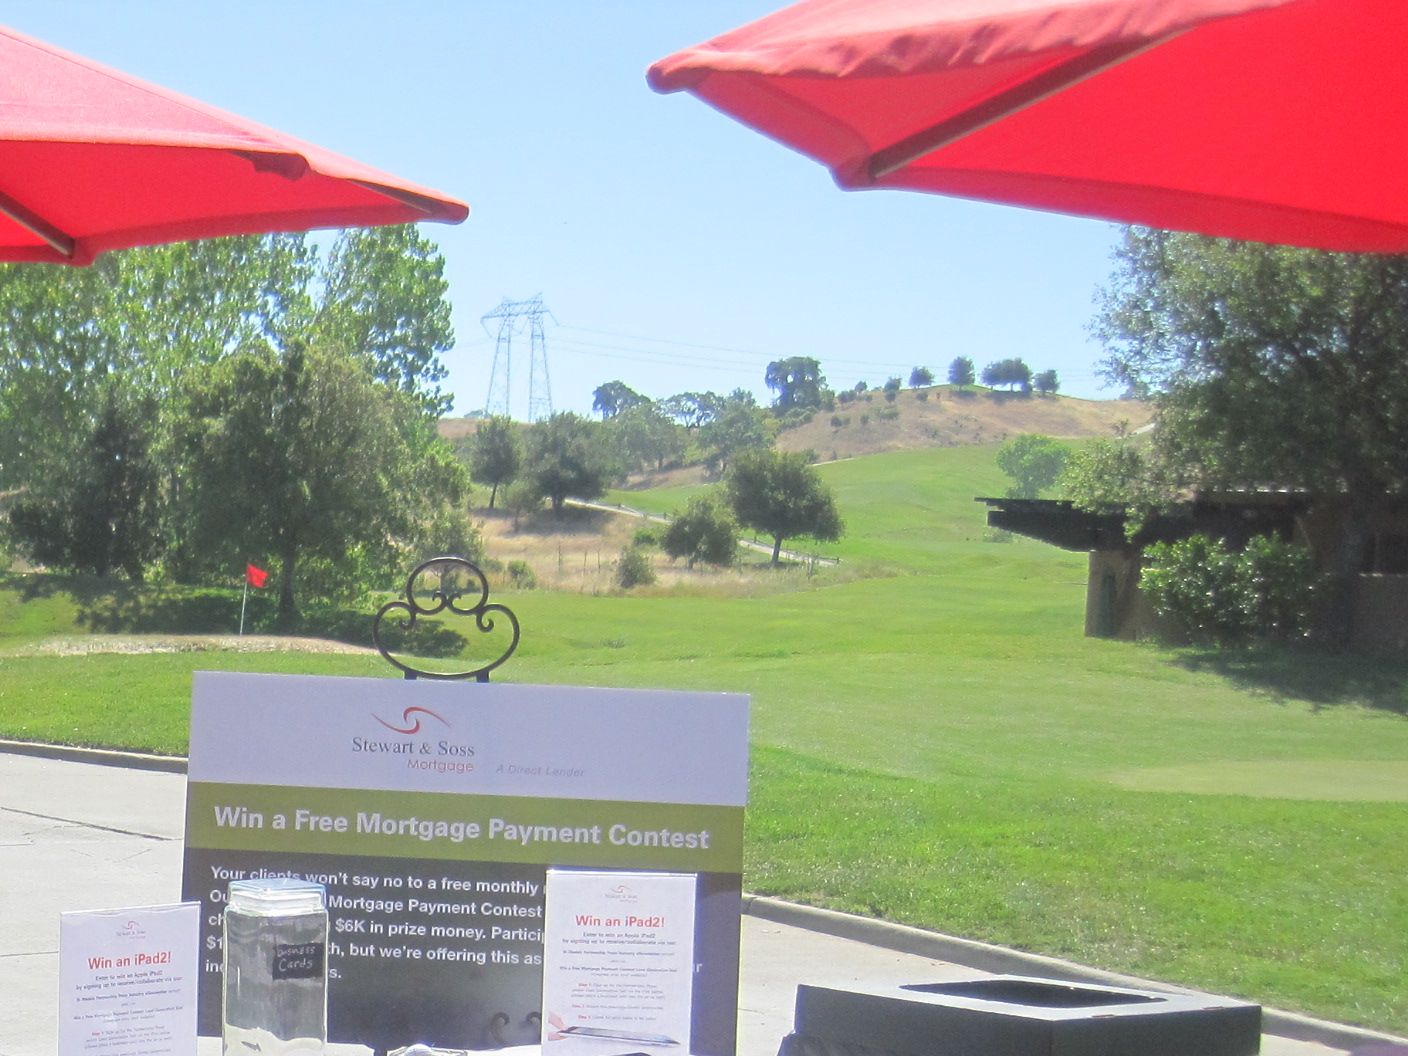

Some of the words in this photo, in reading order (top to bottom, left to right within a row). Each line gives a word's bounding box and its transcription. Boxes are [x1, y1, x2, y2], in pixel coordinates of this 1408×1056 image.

[352, 737, 414, 755] Stewart
[419, 742, 431, 755] &
[437, 741, 475, 757] Soss
[407, 758, 474, 774] Mortgage
[214, 806, 264, 829] Win
[272, 814, 286, 830] a
[294, 809, 348, 833] Free
[356, 812, 480, 843] Mortgage
[489, 817, 601, 846] Payment
[608, 823, 710, 850] Contest
[211, 865, 246, 881] Your
[306, 871, 349, 886] won't
[352, 874, 379, 889] say
[383, 876, 403, 889] no
[408, 875, 423, 889] to
[427, 879, 437, 890] a
[441, 877, 472, 891] free
[476, 880, 539, 897] monthly
[328, 895, 404, 914] Mortgage
[408, 899, 476, 916] Payment
[481, 902, 542, 918] Contest
[335, 918, 366, 934] $6K
[370, 920, 384, 934] in
[388, 922, 427, 937] prize
[431, 926, 487, 940] money.
[575, 914, 600, 926] Win
[605, 917, 621, 927] an
[625, 915, 665, 928] iPad2!
[88, 956, 112, 970] Win
[116, 957, 130, 968] an
[134, 951, 171, 966] iPad2!
[278, 958, 313, 972] Cards
[349, 943, 375, 957] but
[379, 945, 422, 959] we're
[426, 949, 487, 965] offering
[491, 950, 520, 964] this
[524, 954, 542, 966] as
